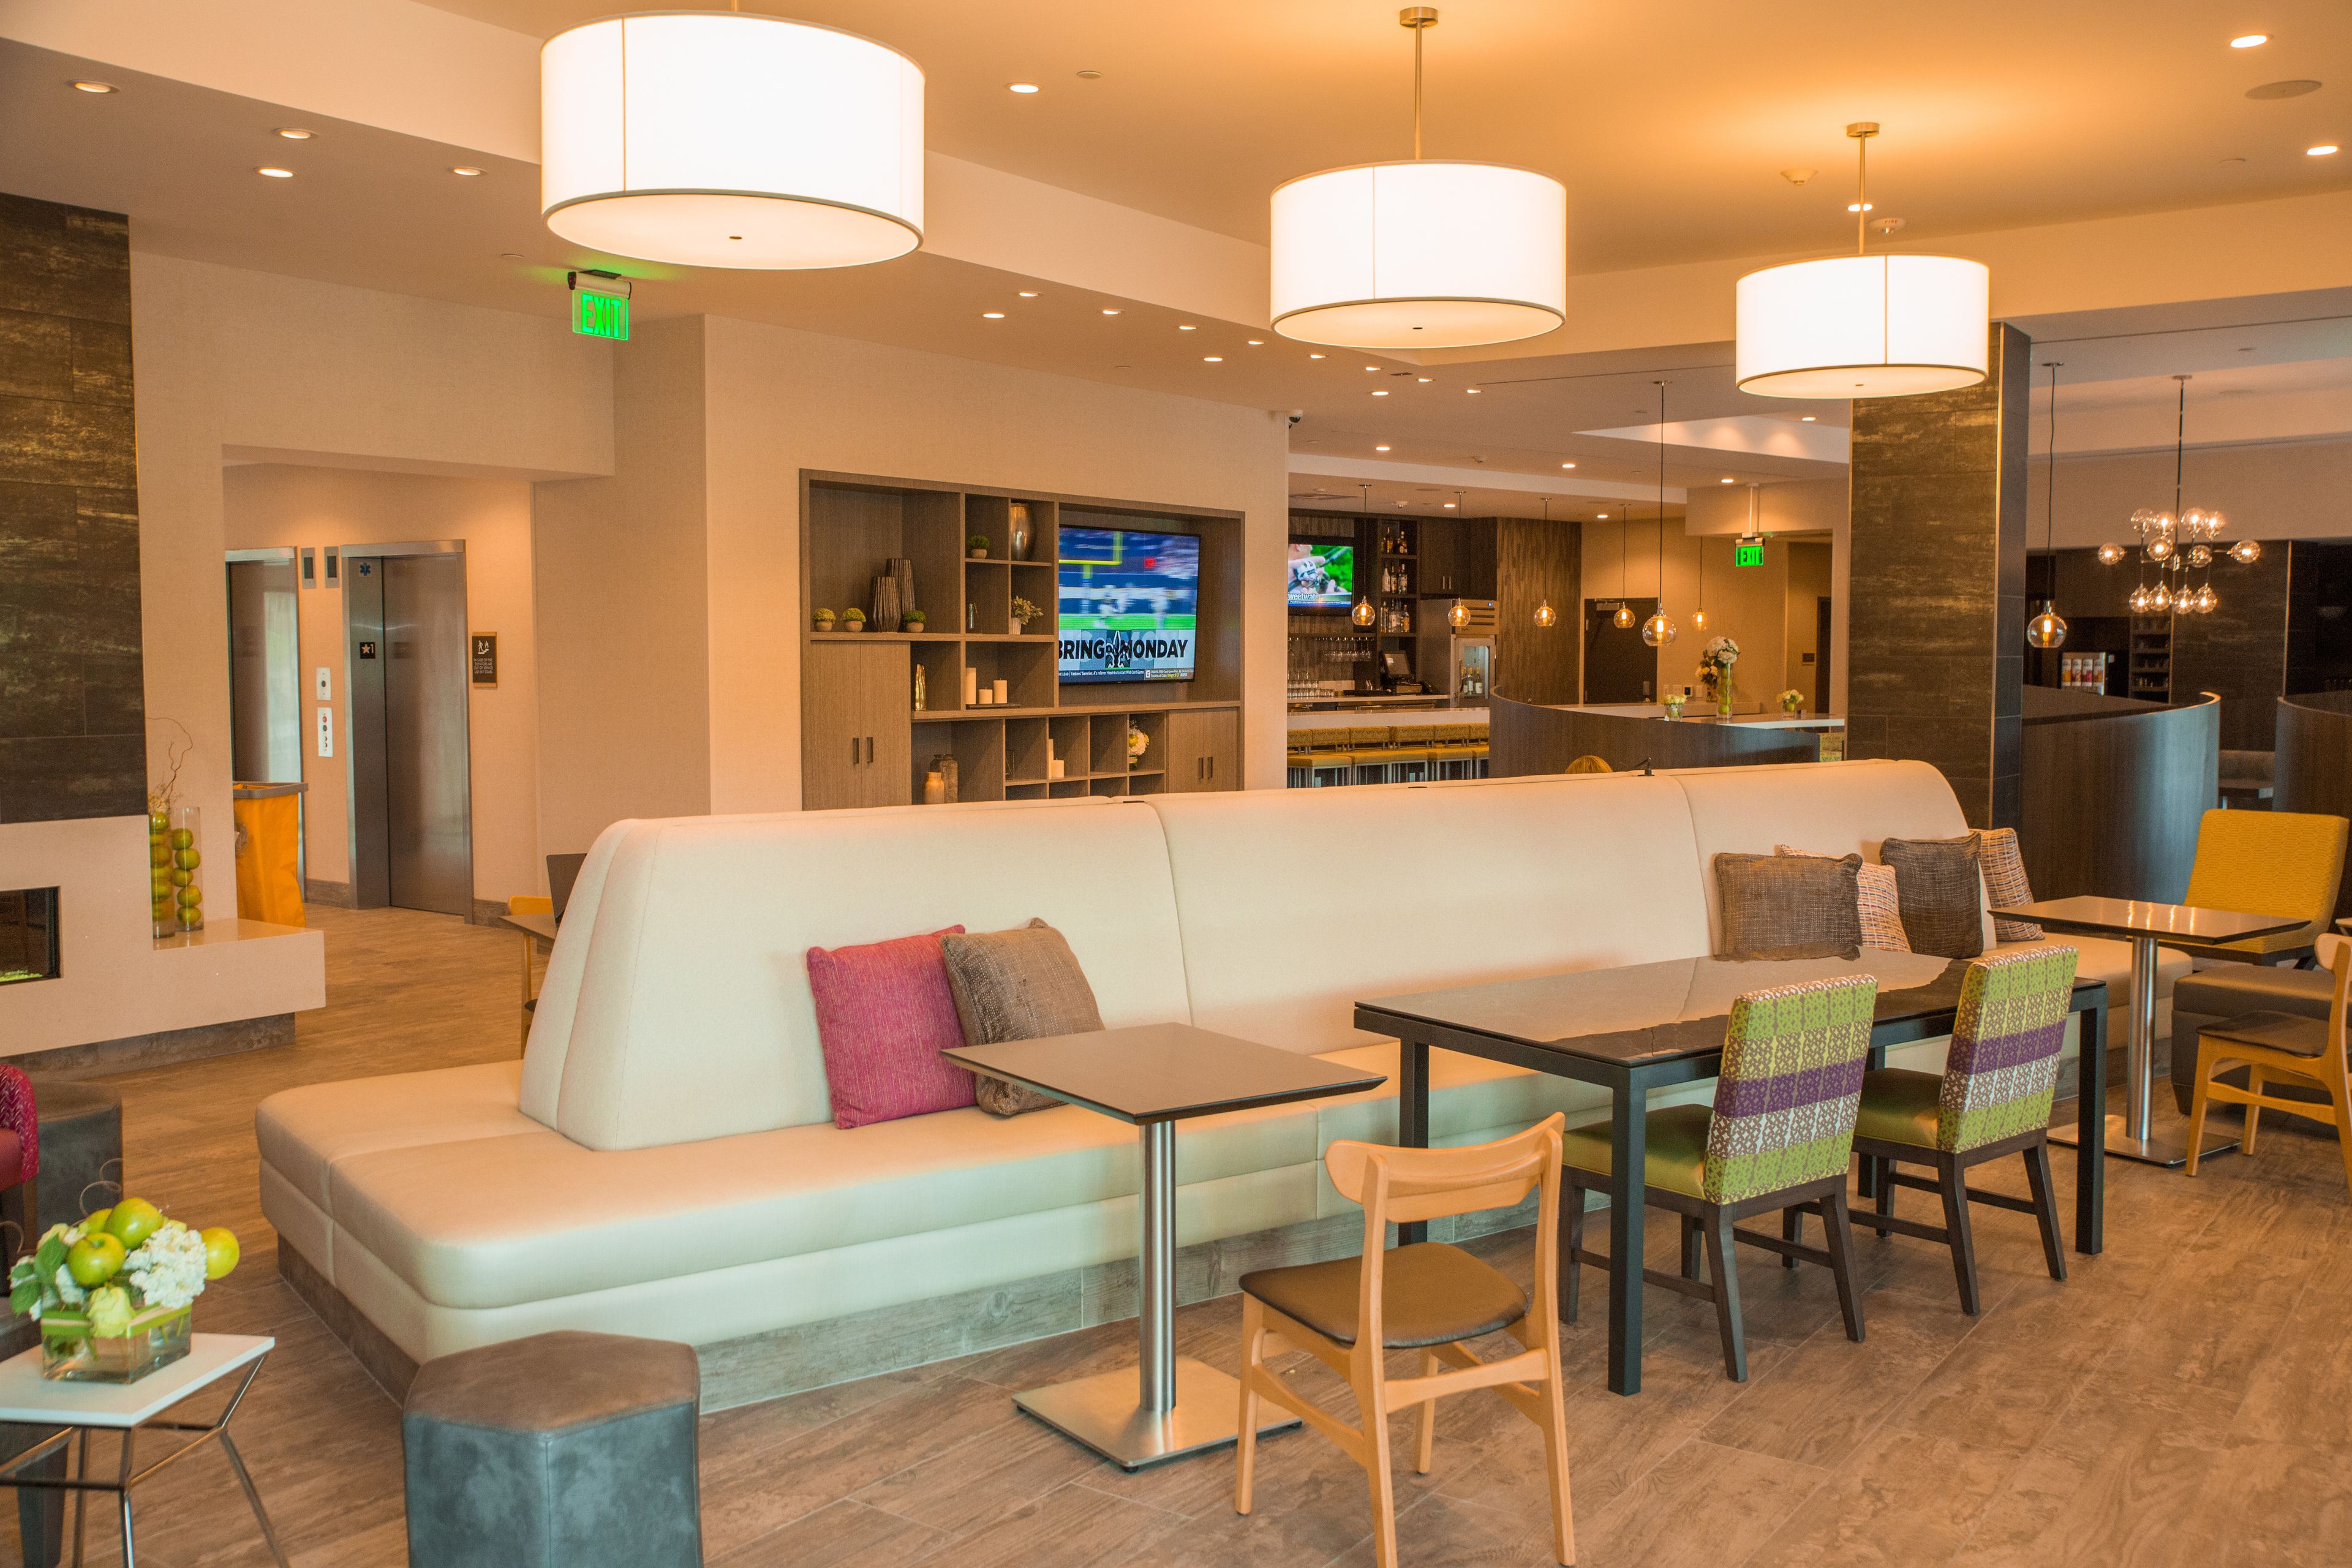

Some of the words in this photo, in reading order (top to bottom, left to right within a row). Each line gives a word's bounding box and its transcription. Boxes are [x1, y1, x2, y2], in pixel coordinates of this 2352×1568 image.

[582, 294, 622, 337] EXIT
[1740, 546, 1761, 565] EXIT
[1120, 639, 1188, 658] MONDAY
